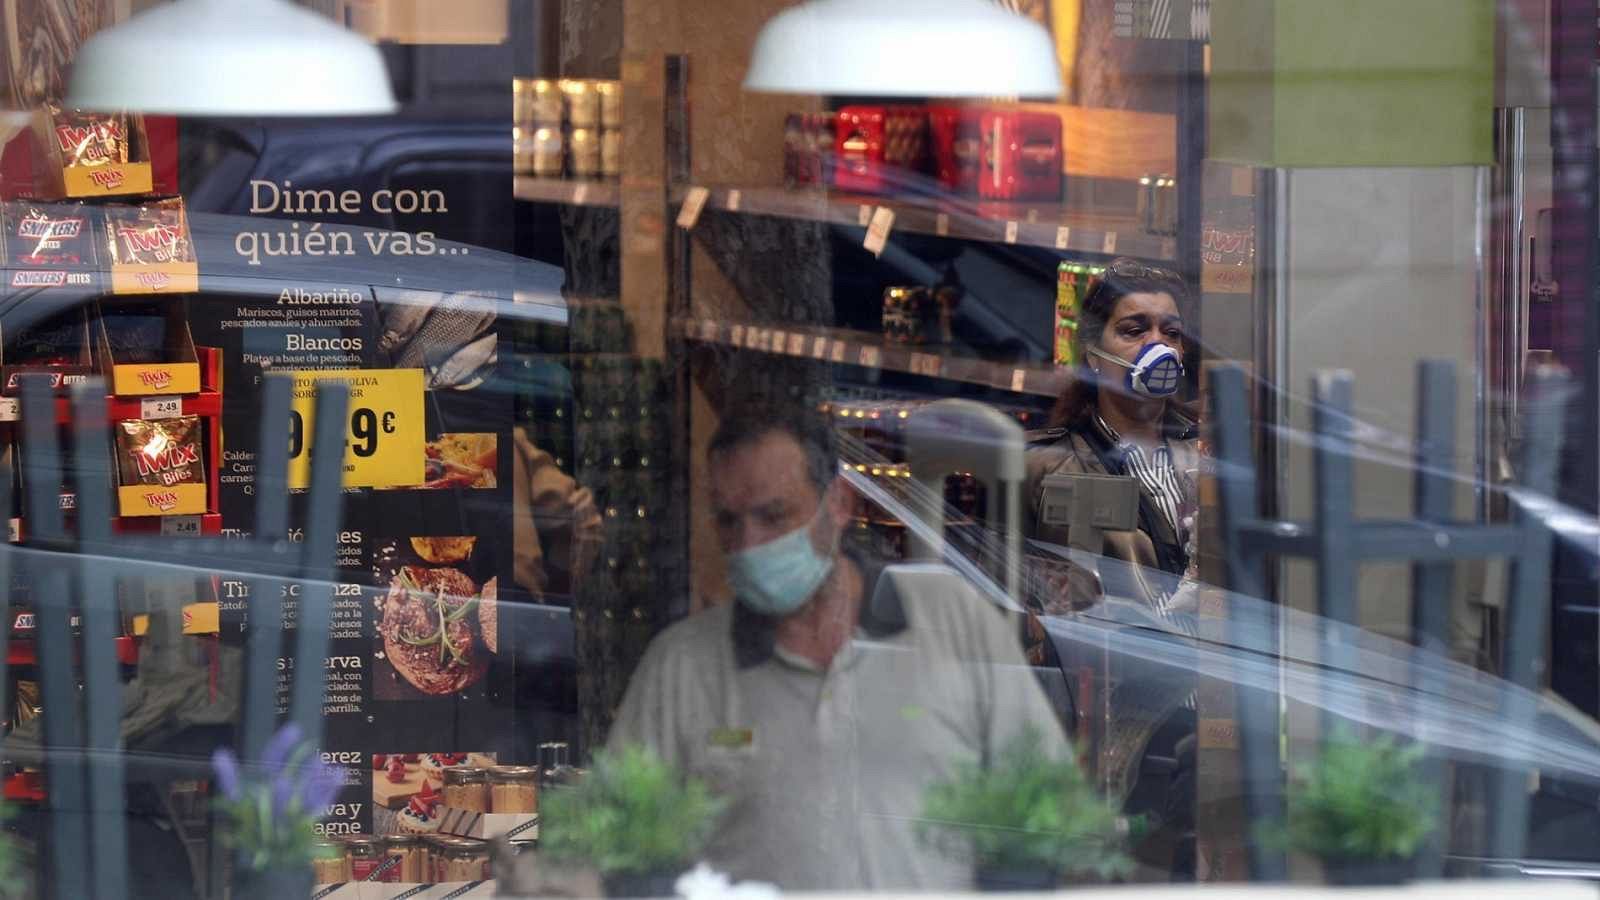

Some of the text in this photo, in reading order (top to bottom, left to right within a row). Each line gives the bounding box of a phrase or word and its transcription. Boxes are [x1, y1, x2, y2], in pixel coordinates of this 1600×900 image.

[250, 180, 448, 214] Dime con
[20, 221, 80, 236] SNIKERS
[234, 222, 469, 266] quién vas...
[67, 273, 90, 284] BITES
[277, 288, 362, 304] Albariño
[237, 307, 362, 318] Mariscos, guisos marinos,
[221, 318, 362, 330] pescados azules y ahumados.
[286, 334, 362, 351] Blancos
[243, 353, 273, 364] Platos
[283, 354, 304, 363] base
[307, 353, 318, 363] de
[320, 353, 362, 364] pescado,
[131, 442, 199, 476] Twix
[223, 451, 256, 462] Calder
[163, 469, 192, 485] Bites
[344, 673, 362, 681] con
[328, 682, 362, 691] ciados.
[324, 693, 362, 703] latos de
[323, 704, 362, 716] parrilla.
[320, 751, 362, 764] erez
[350, 803, 362, 819] y
